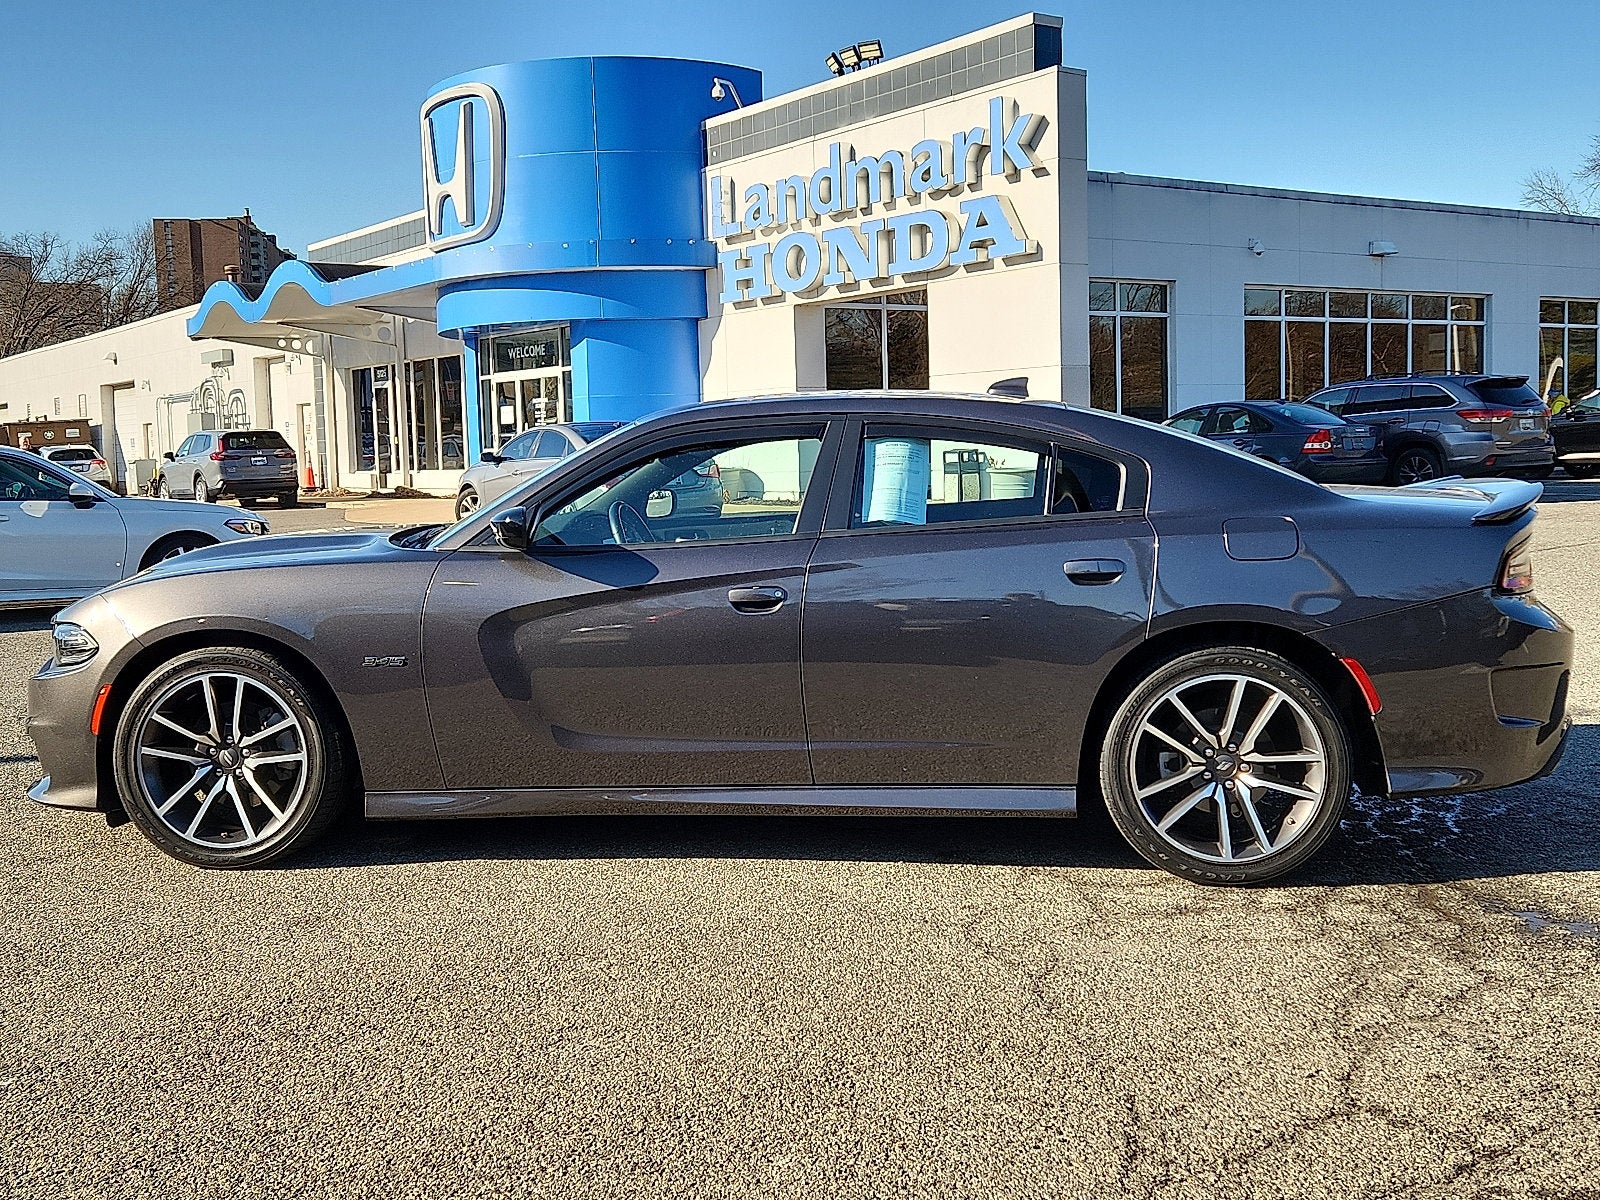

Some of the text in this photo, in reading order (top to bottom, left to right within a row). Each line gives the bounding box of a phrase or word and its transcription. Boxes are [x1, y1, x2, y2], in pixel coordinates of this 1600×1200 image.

[711, 96, 1036, 239] Landmark
[719, 194, 1028, 304] HONDA
[507, 343, 546, 360] WELCOME
[1176, 862, 1246, 881] EAGLE
